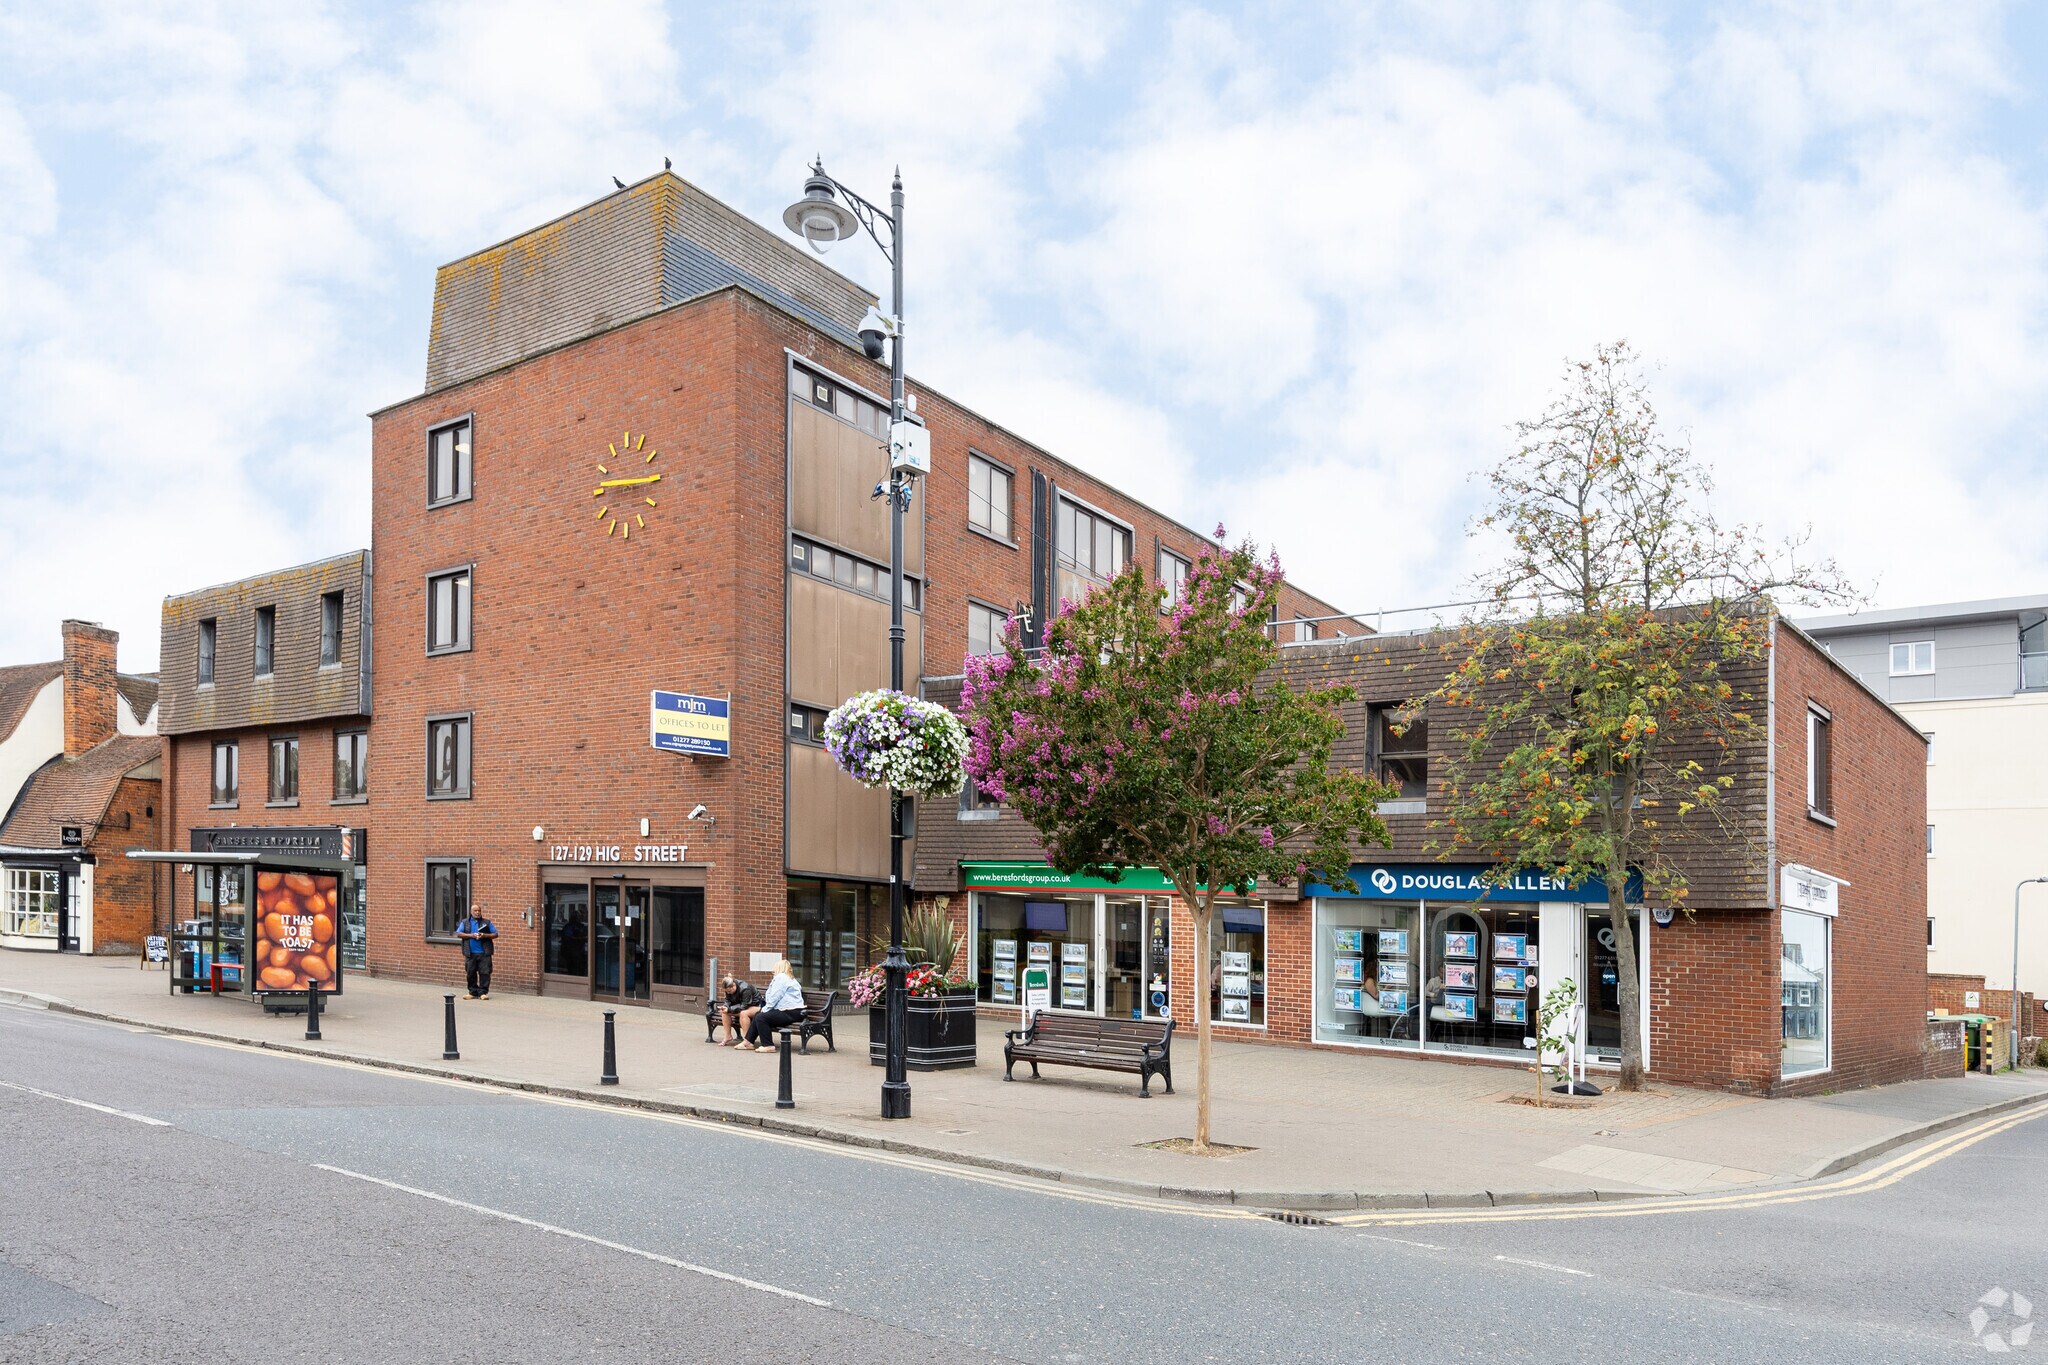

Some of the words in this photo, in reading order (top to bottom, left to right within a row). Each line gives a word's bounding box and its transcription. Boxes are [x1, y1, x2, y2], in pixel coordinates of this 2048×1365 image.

[659, 717, 694, 728] OFFICES
[697, 722, 709, 730] TO
[711, 723, 725, 732] LET
[672, 736, 690, 744] 01277
[264, 836, 322, 846] EMPORIUM
[550, 845, 593, 861] 127-129
[634, 845, 688, 861] STREET
[973, 873, 1071, 884] www.beresfordsgroup.co.uk
[280, 914, 291, 925] IT
[292, 914, 314, 926] HAS
[282, 925, 297, 937] TO
[299, 926, 312, 937] BE
[279, 937, 315, 949] TOAST
